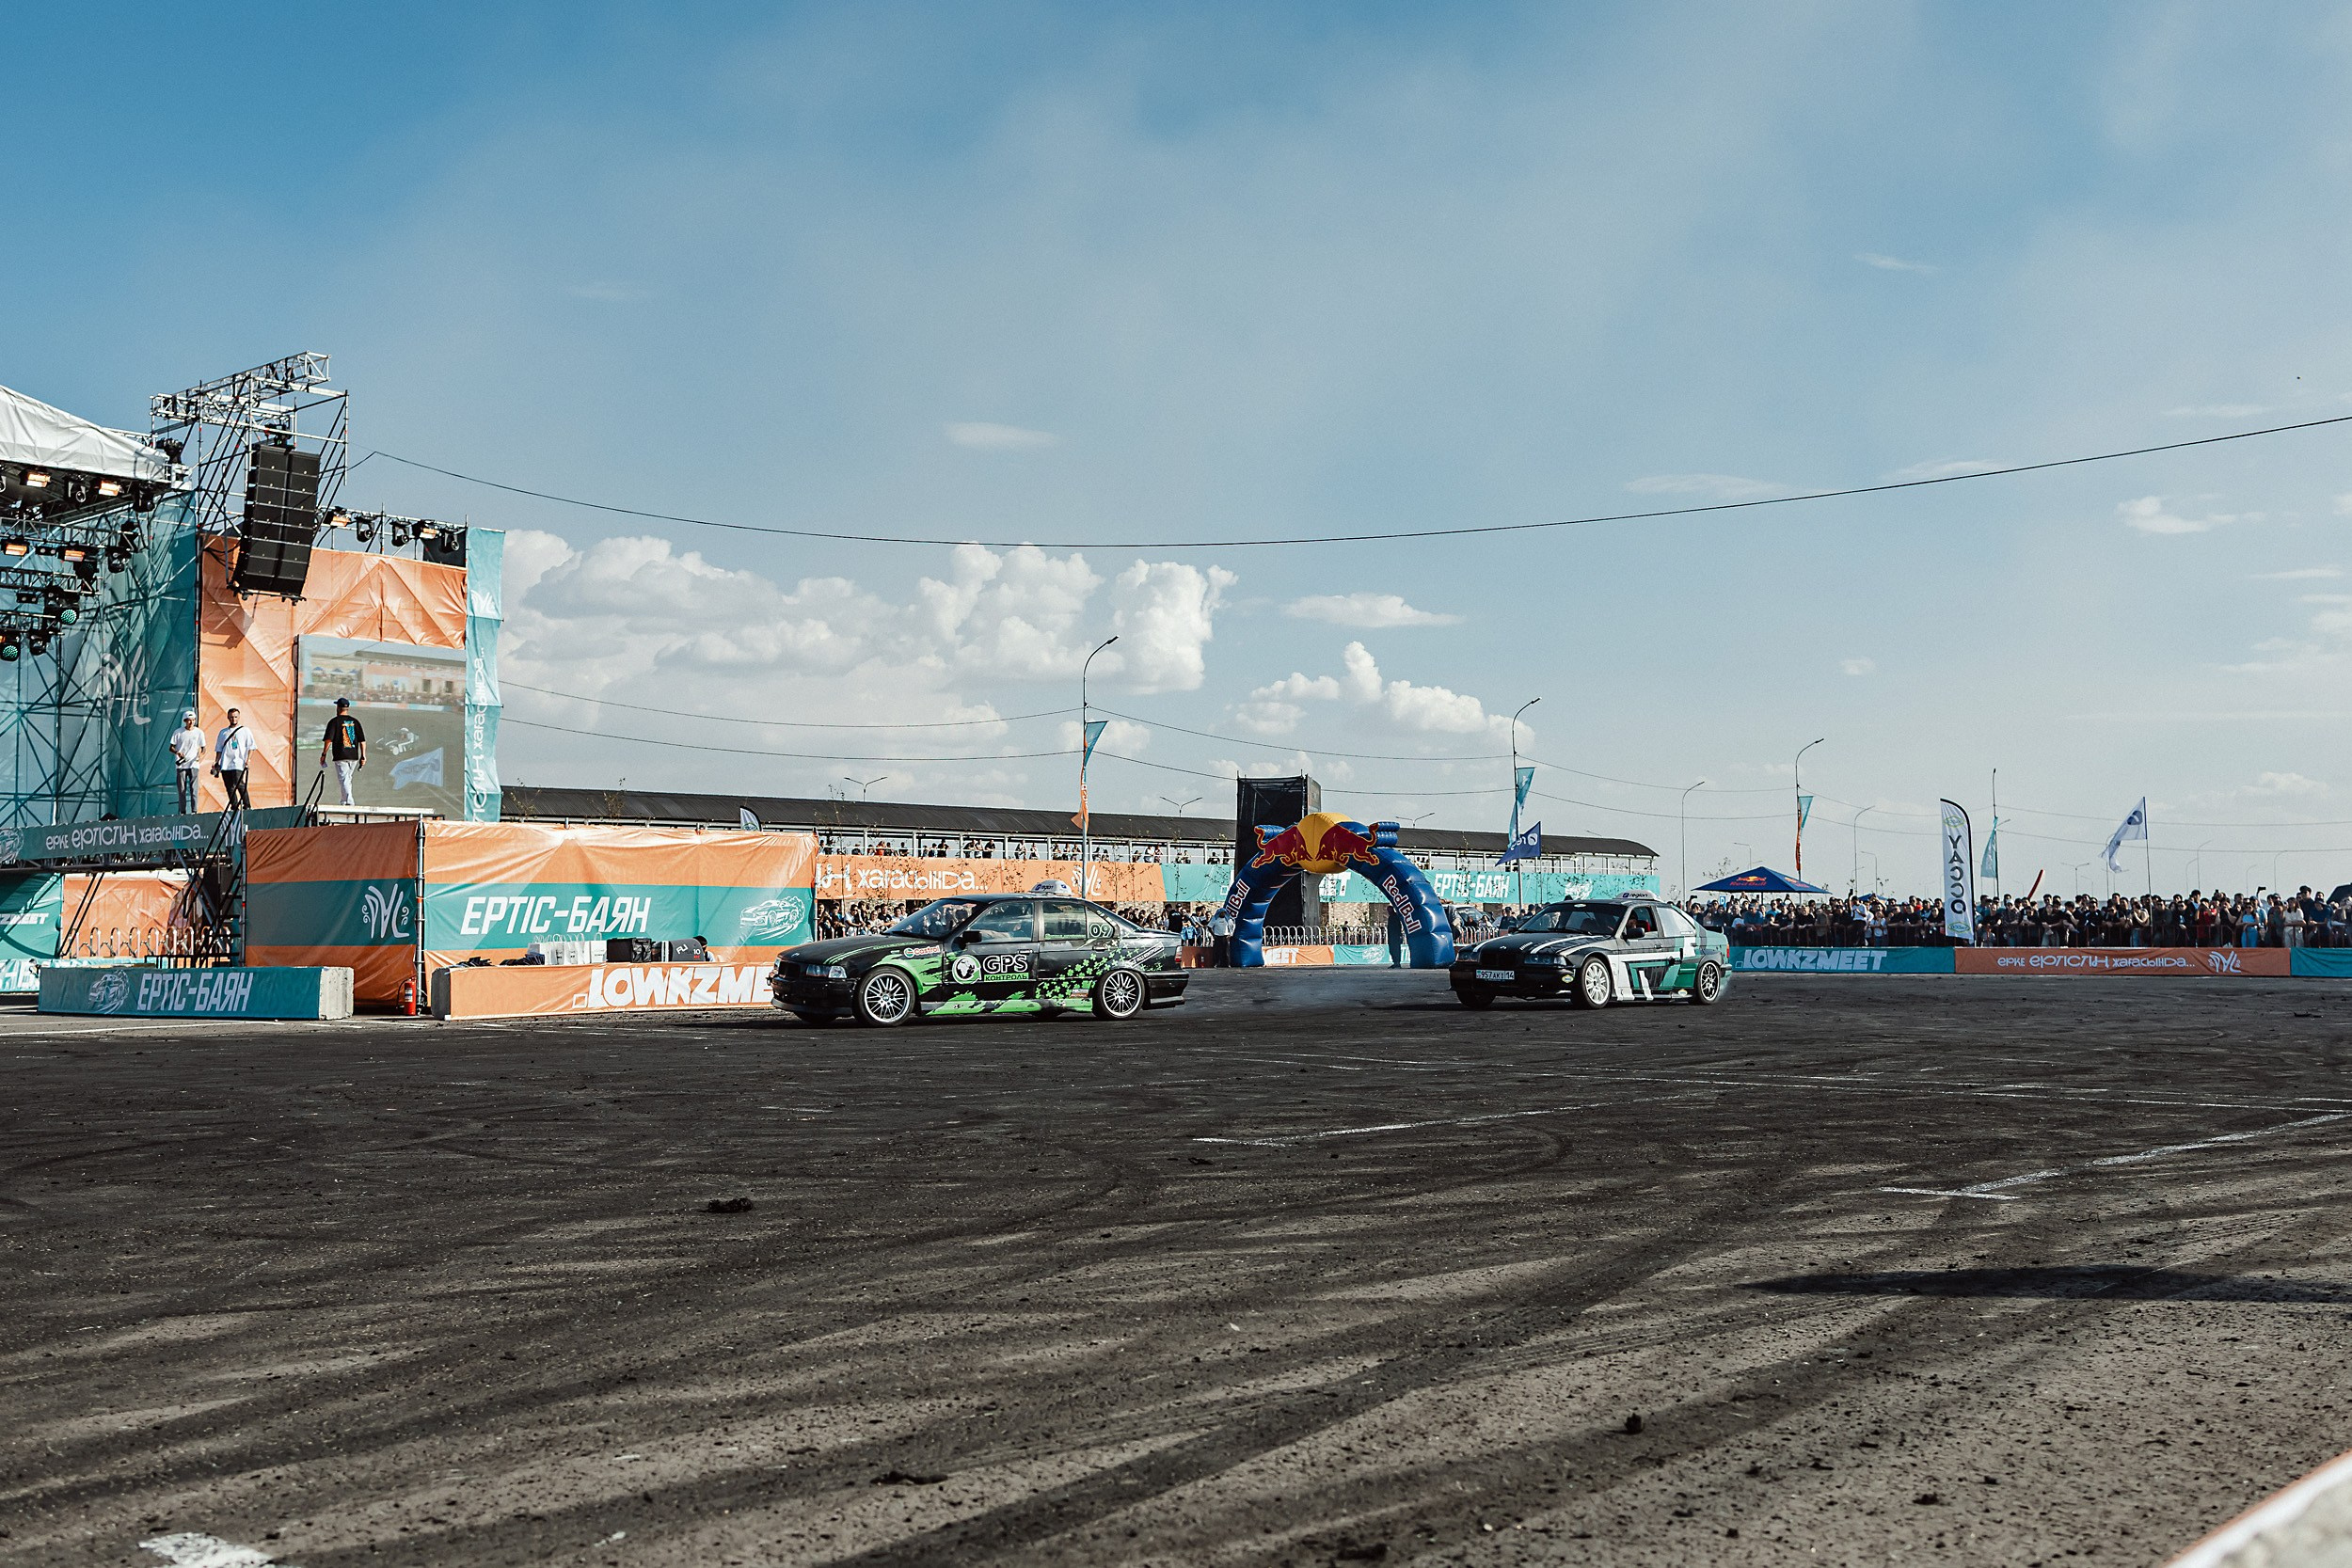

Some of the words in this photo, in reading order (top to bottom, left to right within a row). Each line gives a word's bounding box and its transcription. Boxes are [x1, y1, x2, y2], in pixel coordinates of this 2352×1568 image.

[1230, 878, 1251, 910] Bull
[1382, 874, 1409, 908] Red
[1398, 900, 1422, 935] Bull
[1089, 923, 1114, 938] 09
[914, 945, 940, 956] Castrol
[982, 954, 1028, 974] GPS
